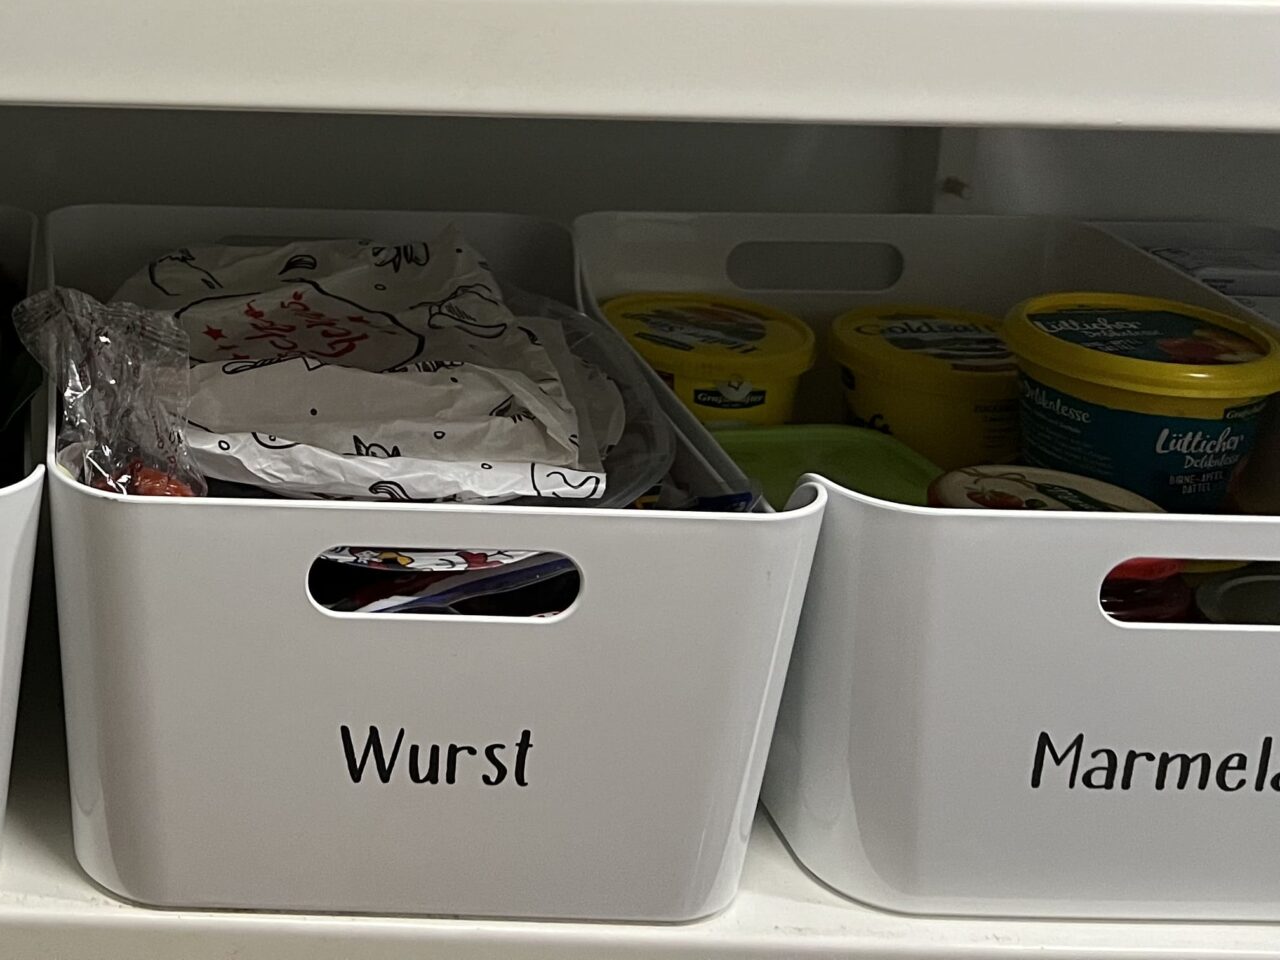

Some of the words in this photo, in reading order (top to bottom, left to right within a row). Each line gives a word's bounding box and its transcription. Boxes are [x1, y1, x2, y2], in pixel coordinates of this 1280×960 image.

[1155, 426, 1244, 454] Lütticher
[341, 725, 533, 786] Wurst
[1031, 731, 1280, 792] Marmel
